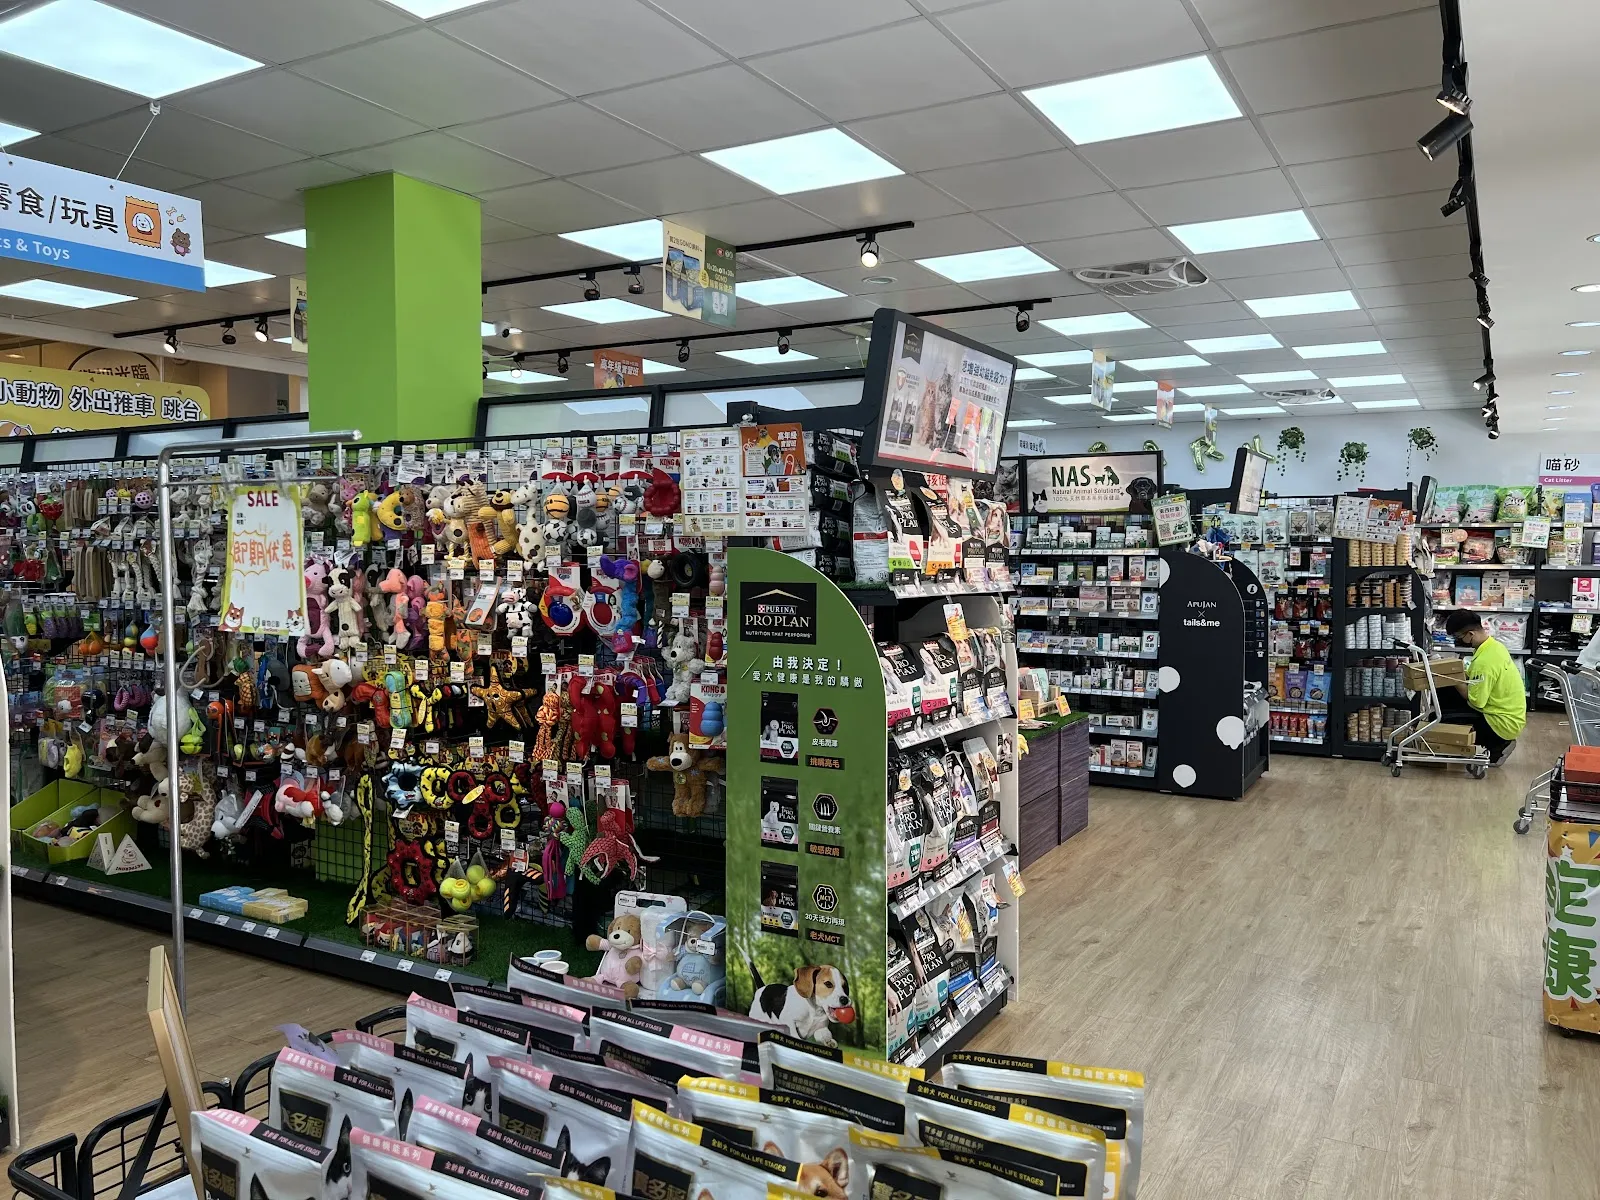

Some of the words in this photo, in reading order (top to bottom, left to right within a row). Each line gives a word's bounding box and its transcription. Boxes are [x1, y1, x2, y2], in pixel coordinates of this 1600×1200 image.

[16, 238, 28, 252] &
[33, 241, 70, 260] Toys
[71, 386, 154, 416] 外出推車
[162, 397, 201, 421] 跳台
[1052, 465, 1090, 487] NAS
[247, 490, 280, 507] SALE
[745, 614, 772, 626] PRO
[774, 616, 810, 628] PLAN
[1184, 618, 1220, 627] tails&me
[752, 670, 863, 688] 愛犬健康是我的驕傲
[898, 818, 924, 836] PLAN
[820, 894, 832, 902] MCT
[923, 956, 944, 974] PLAN
[897, 982, 918, 1000] PLAN
[479, 1022, 487, 1030] FOR
[496, 1026, 504, 1034] LIFE
[504, 1029, 520, 1039] STAGES
[618, 1015, 626, 1023] FOR
[627, 1017, 635, 1025] ALL
[636, 1020, 645, 1028] LIFE
[646, 1022, 662, 1032] STAGES
[682, 1032, 731, 1052] 健康機能系列
[786, 1038, 795, 1047] FOR
[796, 1041, 804, 1049] ALL
[805, 1044, 814, 1052] LIFE
[815, 1046, 833, 1057] STAGES
[952, 1054, 972, 1062] 全齡犬
[1011, 1060, 1034, 1068] STAGES
[1062, 1066, 1128, 1082] 健康機能系列
[358, 1078, 367, 1089] FOR
[376, 1084, 384, 1094] LIFE
[385, 1087, 394, 1097] STA
[576, 1090, 586, 1100] FOR
[586, 1094, 594, 1103] ALL
[595, 1097, 604, 1106] LIFE
[605, 1100, 622, 1113] STAGES
[771, 1094, 790, 1104] 全齡犬
[792, 1098, 804, 1107] FOR
[805, 1101, 815, 1110] ALL
[816, 1104, 827, 1113] LIFE
[828, 1106, 849, 1118] STAGES
[917, 1085, 936, 1096] 全齡犬
[938, 1091, 949, 1101] FOR
[950, 1094, 961, 1104] ALL
[962, 1097, 973, 1106] LIFE
[974, 1100, 996, 1112] STAGES
[279, 1136, 288, 1146] FOR
[296, 1141, 305, 1151] LIFE
[305, 1144, 321, 1157] STAGES
[362, 1134, 421, 1160] 健康機能系列
[503, 1135, 513, 1146] FOR
[514, 1139, 523, 1149] ALL
[523, 1142, 533, 1153] LIFE
[534, 1146, 552, 1160] STAGES
[711, 1138, 728, 1151] 全齡犬
[730, 1147, 741, 1158] FOR
[742, 1151, 752, 1162] ALL
[753, 1154, 764, 1165] LIFE
[765, 1158, 787, 1172] STAGES
[444, 1161, 465, 1174] 全齡貓
[466, 1169, 479, 1181] FOR
[480, 1173, 491, 1185] ALL
[492, 1177, 505, 1189] LIFE
[506, 1181, 530, 1196] STAGES
[979, 1160, 991, 1171] FOR
[993, 1164, 1004, 1175] ALL
[1006, 1168, 1018, 1180] LIFE
[1020, 1173, 1044, 1187] STAGES
